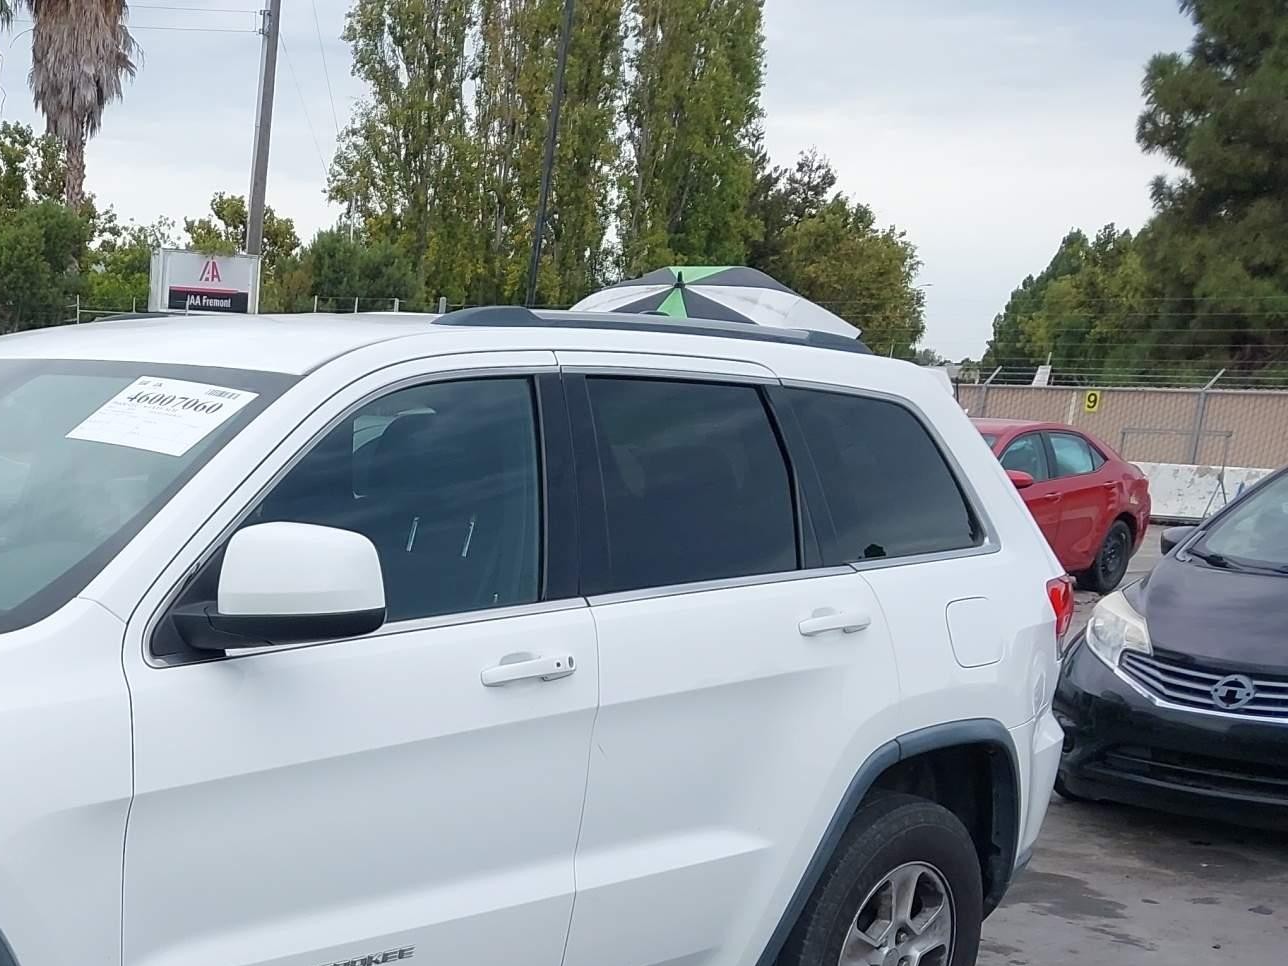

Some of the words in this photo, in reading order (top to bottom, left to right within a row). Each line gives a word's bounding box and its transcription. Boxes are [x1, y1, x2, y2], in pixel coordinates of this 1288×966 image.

[202, 295, 231, 308] Fremont
[126, 390, 224, 414] 46007060
[1087, 392, 1098, 409] 9
